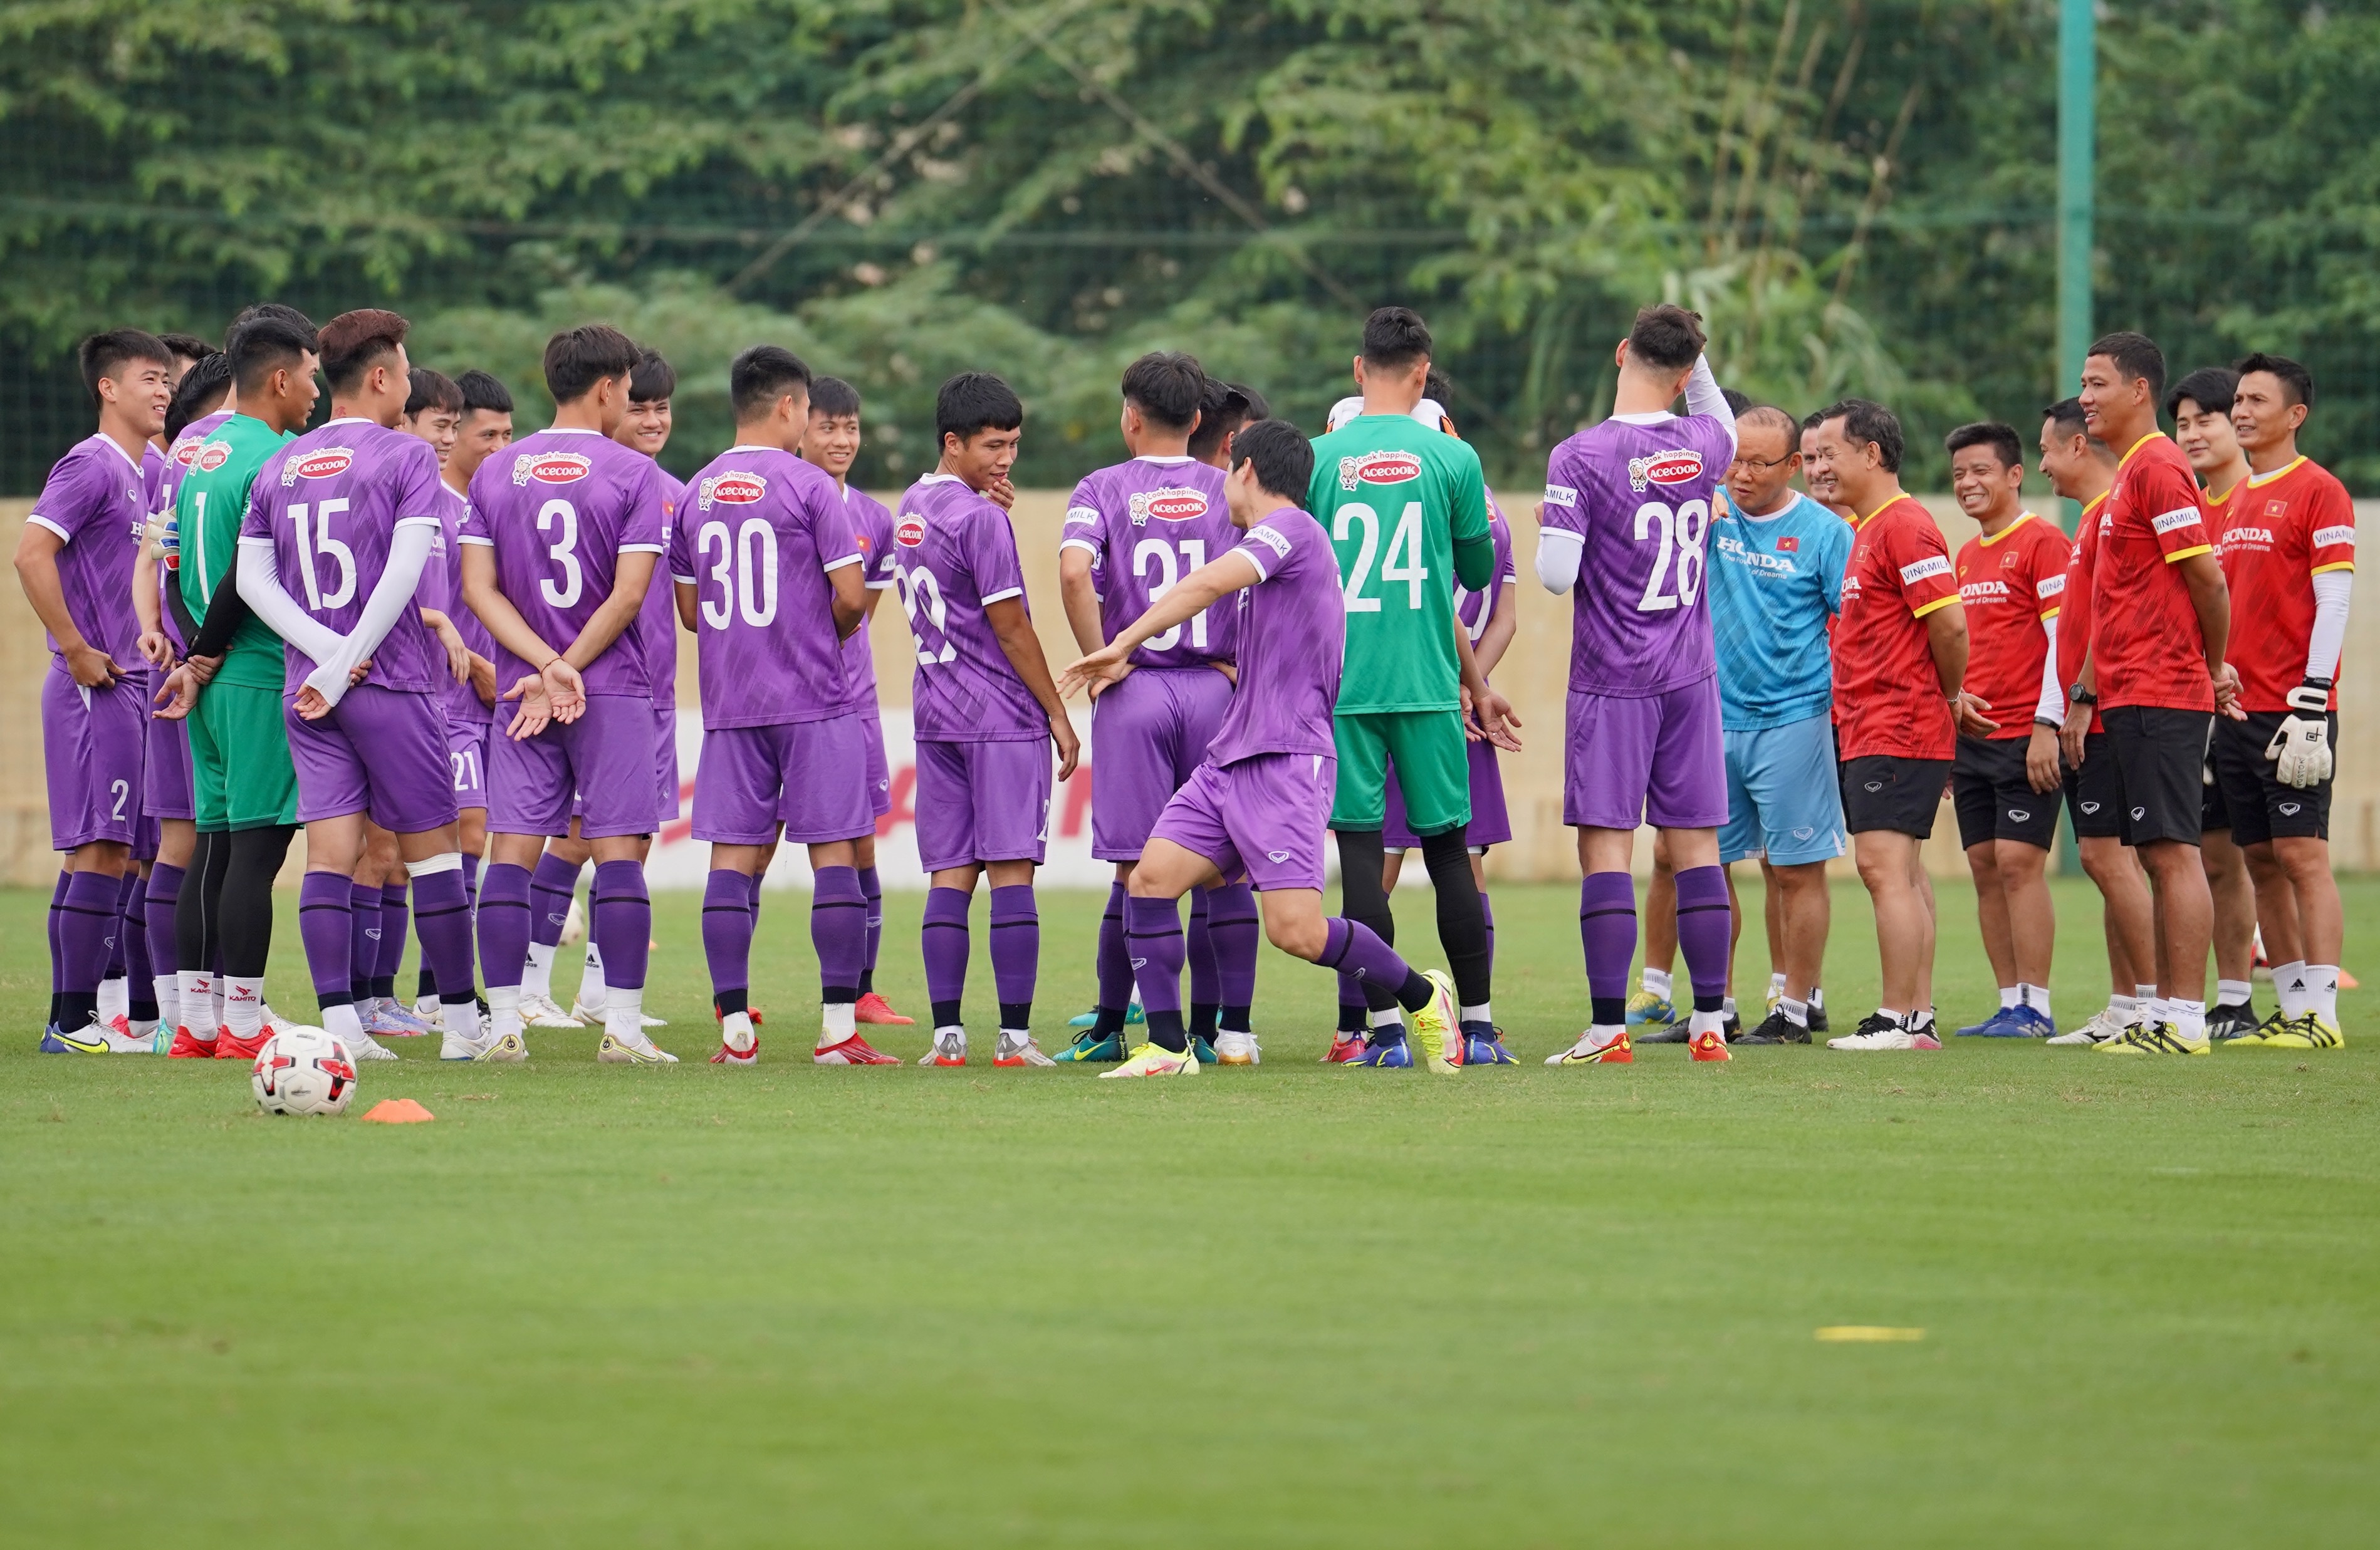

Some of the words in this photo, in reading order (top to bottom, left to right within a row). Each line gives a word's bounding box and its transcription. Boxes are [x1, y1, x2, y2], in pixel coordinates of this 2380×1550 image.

[300, 451, 318, 462] Cook
[320, 447, 352, 455] happiness
[533, 454, 552, 462] Cook
[555, 453, 590, 465] happiness
[1357, 452, 1377, 464] Cook
[1379, 450, 1419, 463] happiness
[1644, 455, 1662, 466] Cook
[1663, 450, 1701, 459] happiness
[714, 473, 728, 485] Cook
[730, 471, 765, 486] happiness
[1147, 489, 1166, 500] Cook
[1167, 487, 1205, 499] happiness
[1066, 511, 1095, 521] MILK
[2154, 511, 2200, 531] VINAMILK
[2222, 528, 2275, 545] HONDA
[194, 491, 210, 605] 1
[287, 497, 357, 611] 15
[536, 499, 583, 609] 3
[1333, 501, 1428, 612] 24
[1634, 499, 1709, 611] 28
[1722, 551, 1735, 562] The
[697, 518, 778, 630] 30
[1760, 569, 1788, 580] Dreams
[1959, 581, 2010, 598] ONDA
[2038, 578, 2066, 593] VINA
[1133, 538, 1208, 652] 31
[450, 751, 478, 791] 21
[111, 779, 129, 821] 2
